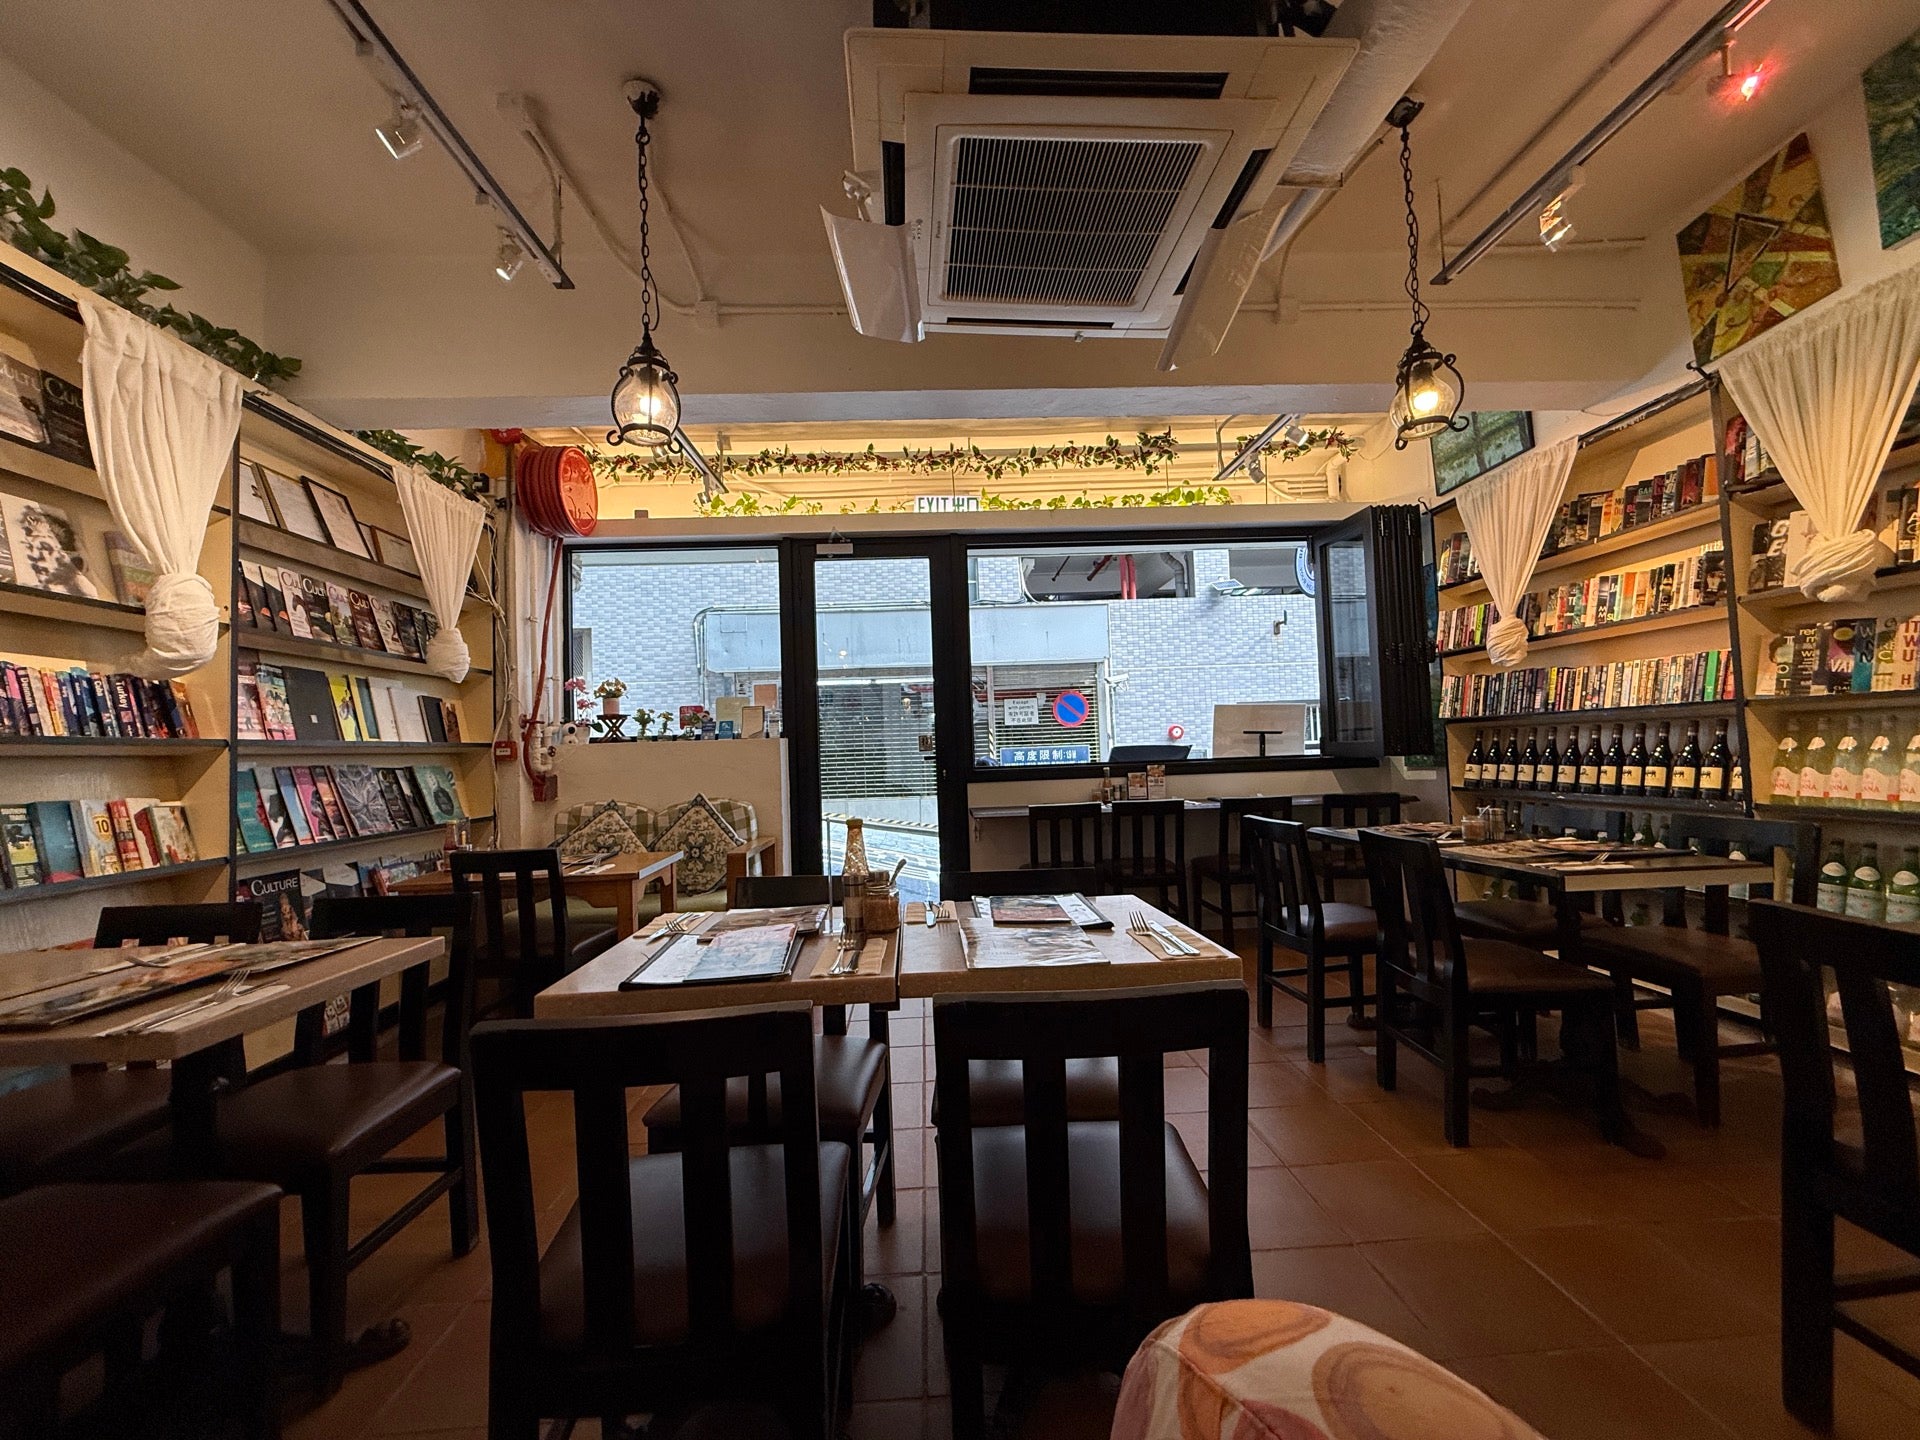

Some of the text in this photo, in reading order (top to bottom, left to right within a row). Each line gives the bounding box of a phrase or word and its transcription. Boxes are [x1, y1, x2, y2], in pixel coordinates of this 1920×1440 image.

[917, 497, 949, 513] EXIT
[115, 680, 129, 708] Turkey
[95, 819, 110, 835] 10
[250, 876, 299, 897] CULTURE
